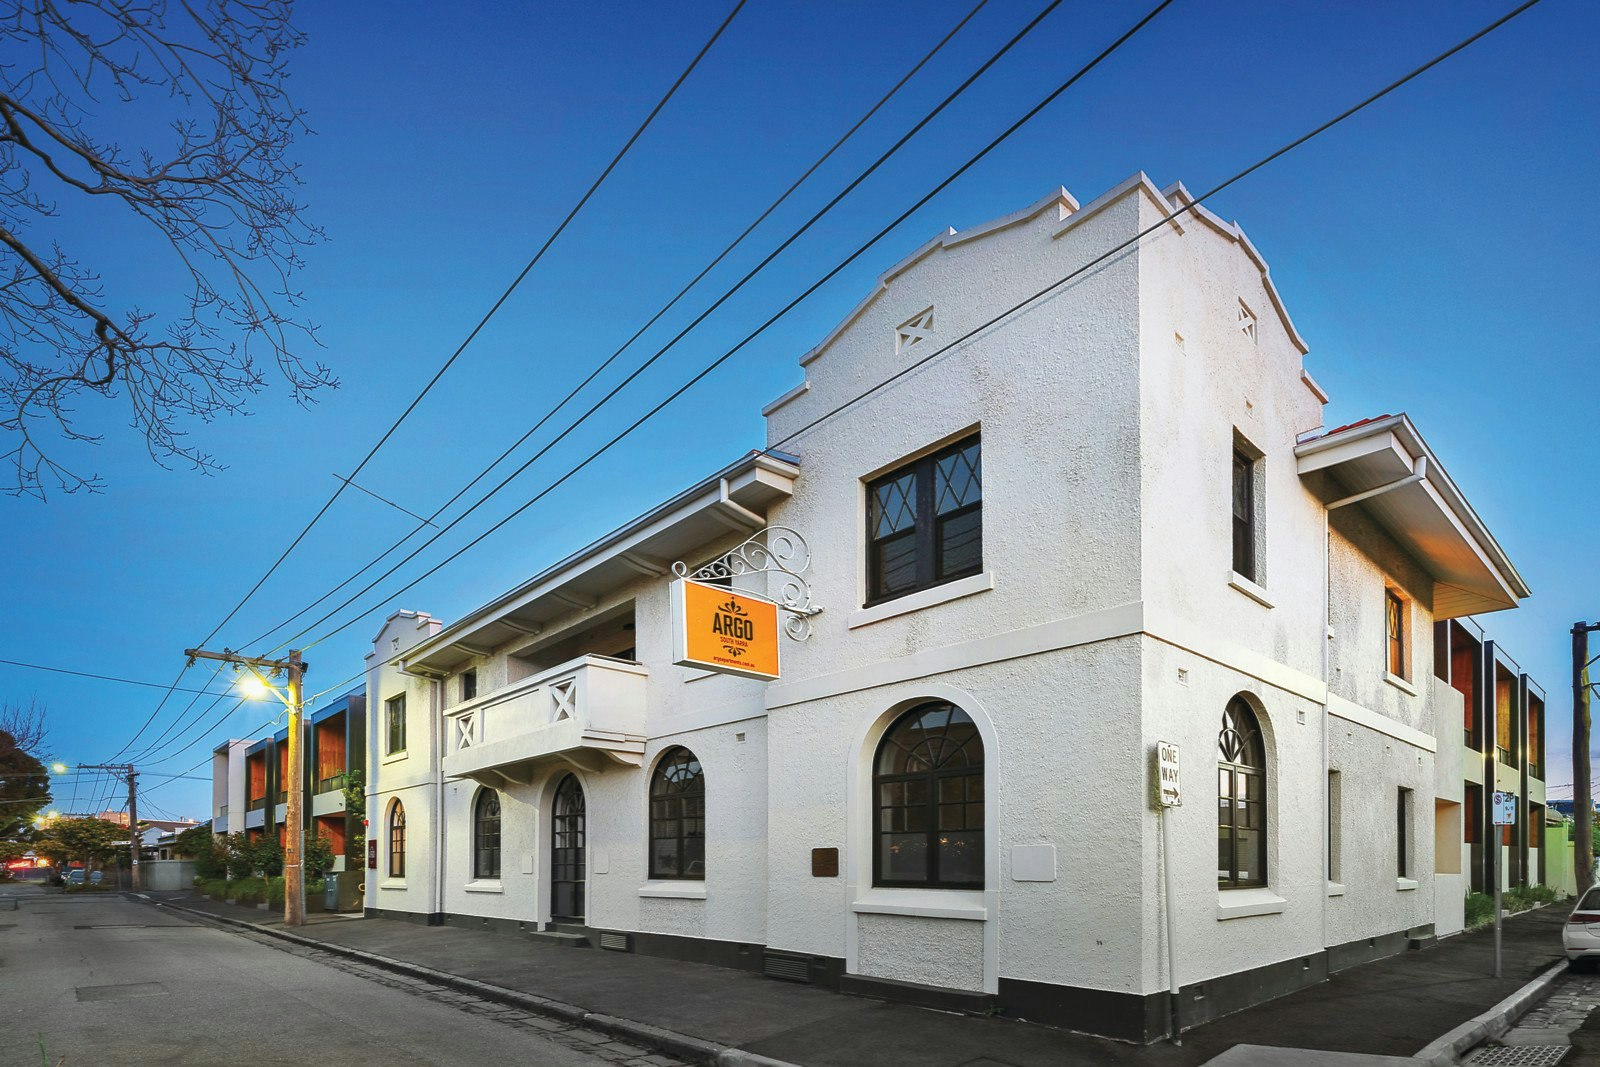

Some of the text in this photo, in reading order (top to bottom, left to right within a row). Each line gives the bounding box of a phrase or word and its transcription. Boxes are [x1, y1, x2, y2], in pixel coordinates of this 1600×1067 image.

[713, 612, 753, 641] ARGO
[720, 636, 748, 647] SOUTH YARRA
[1161, 747, 1177, 764] ONE
[1161, 766, 1178, 783] WAY
